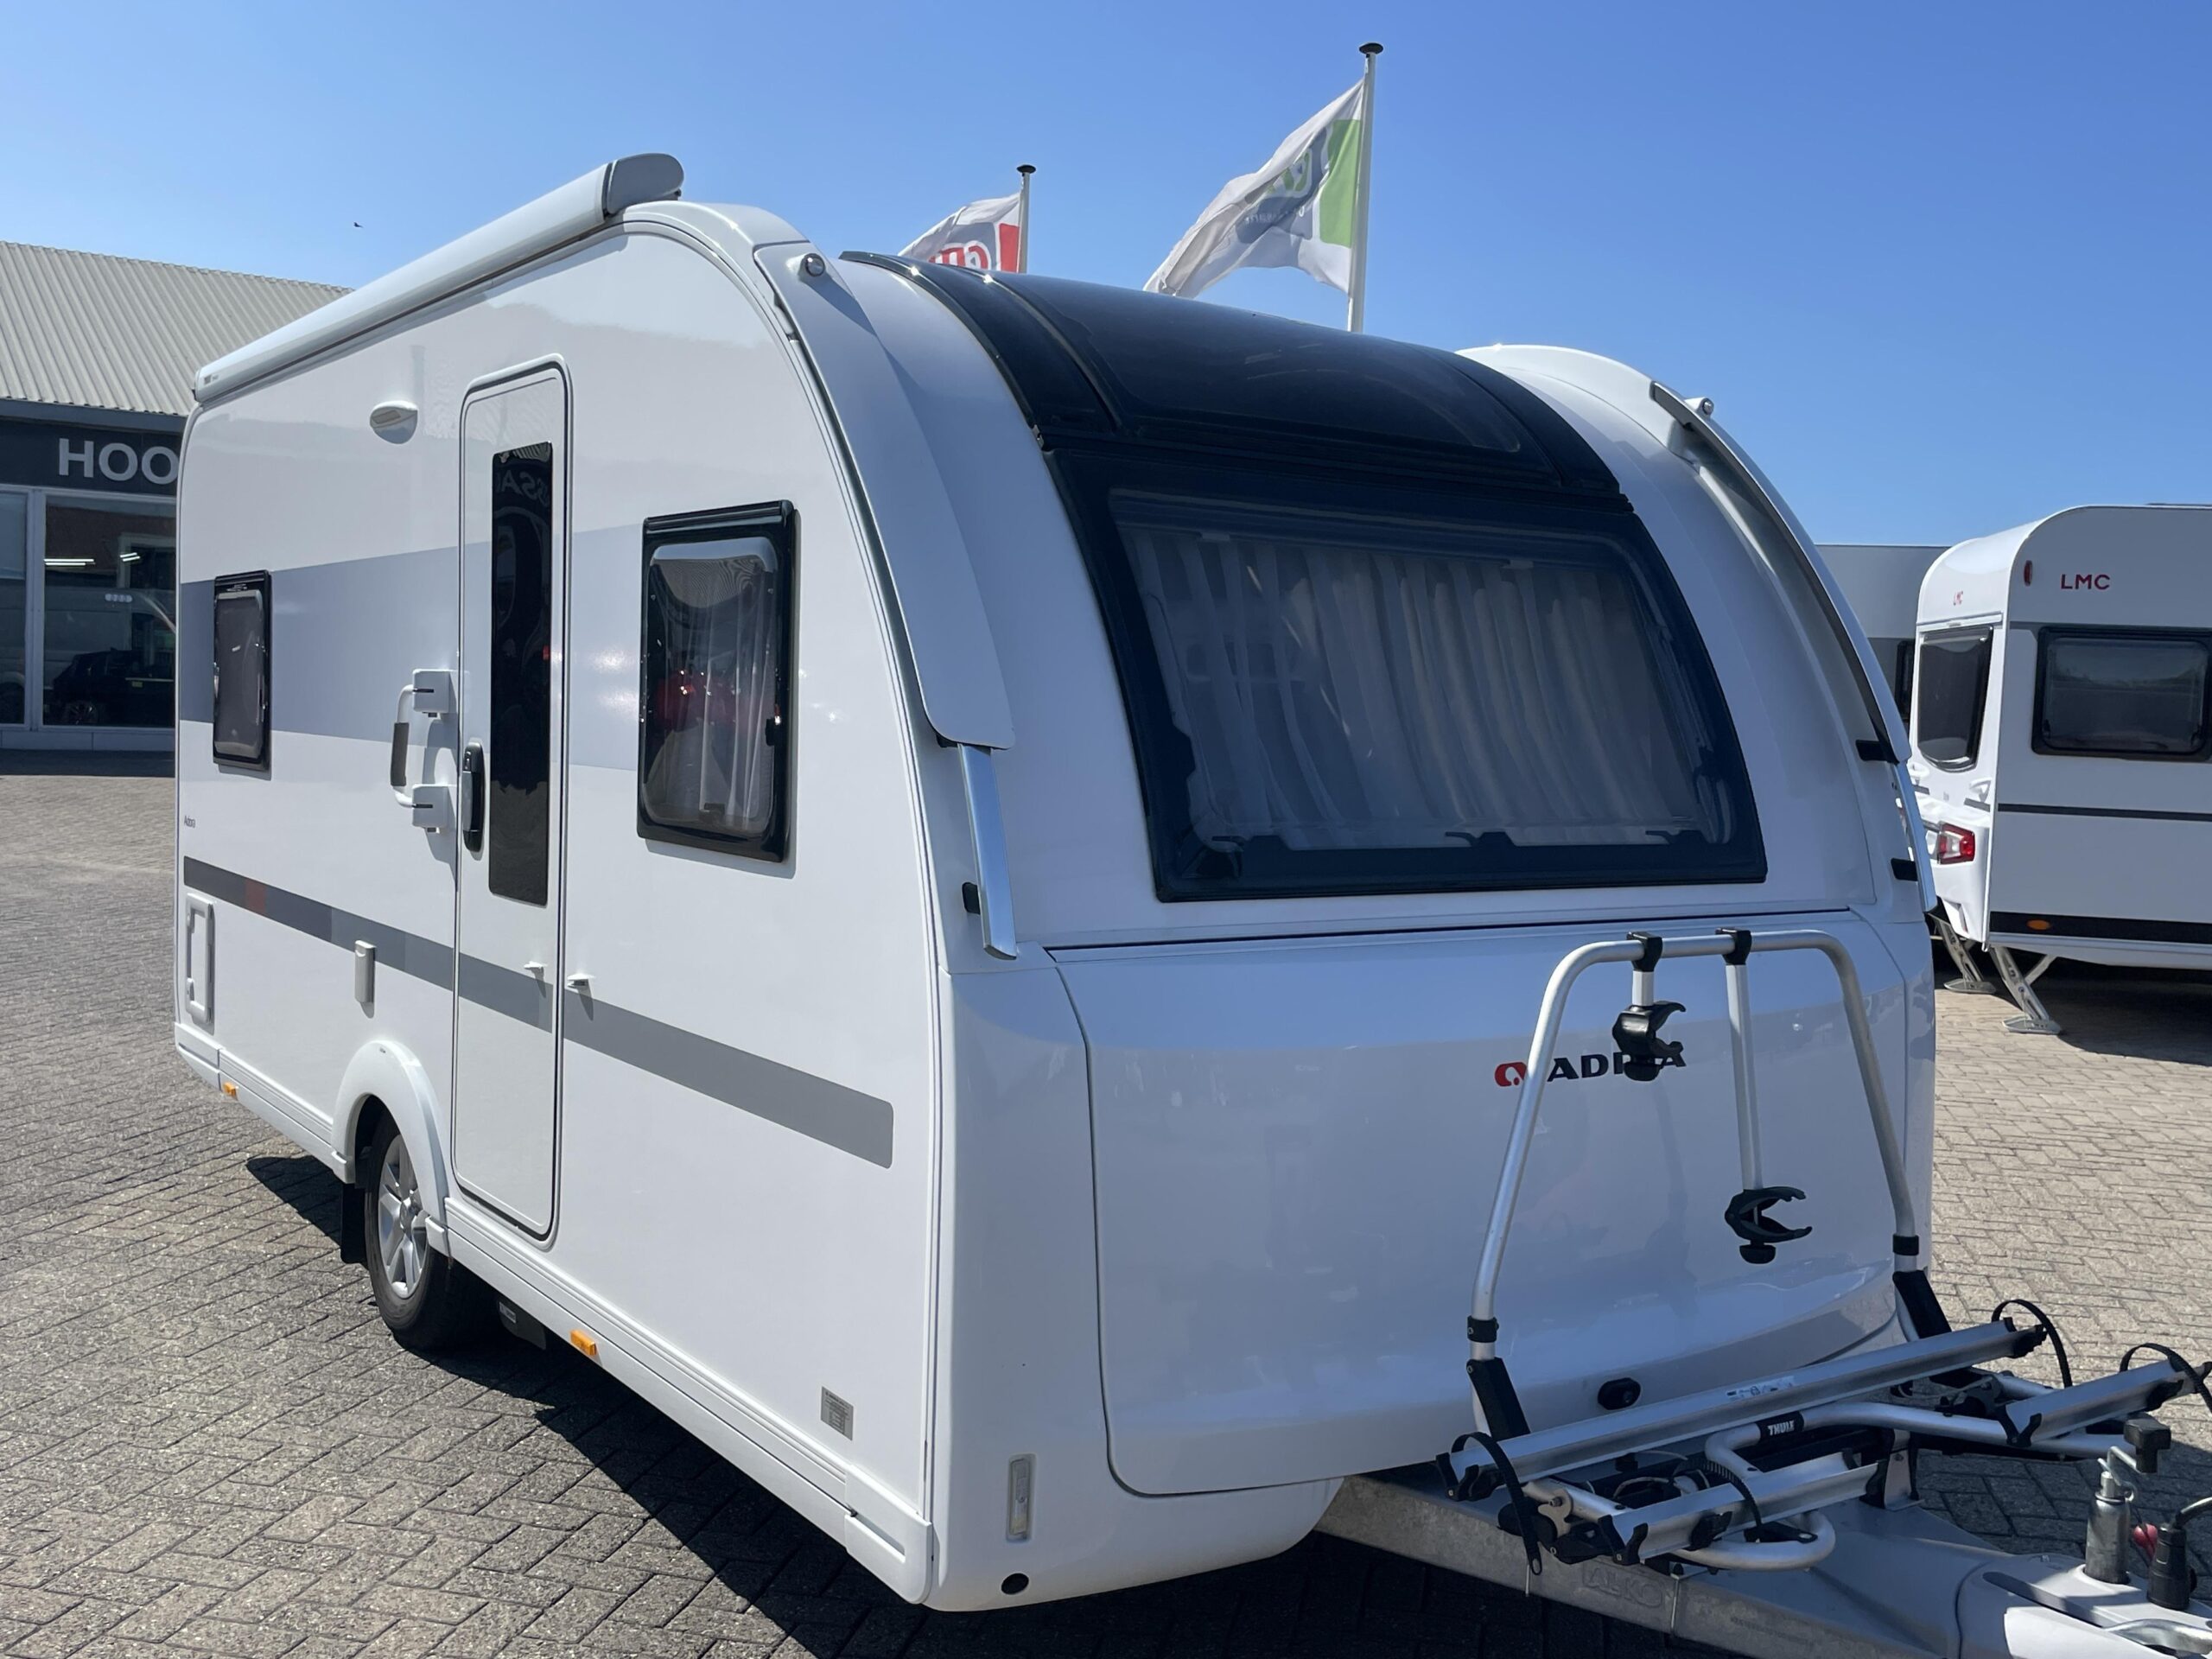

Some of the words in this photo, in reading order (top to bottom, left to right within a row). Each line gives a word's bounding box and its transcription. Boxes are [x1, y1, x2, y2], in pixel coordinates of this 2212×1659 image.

[2060, 573, 2110, 590] LMC
[1547, 1052, 1687, 1082] ADA
[1767, 1420, 1795, 1436] THULE
